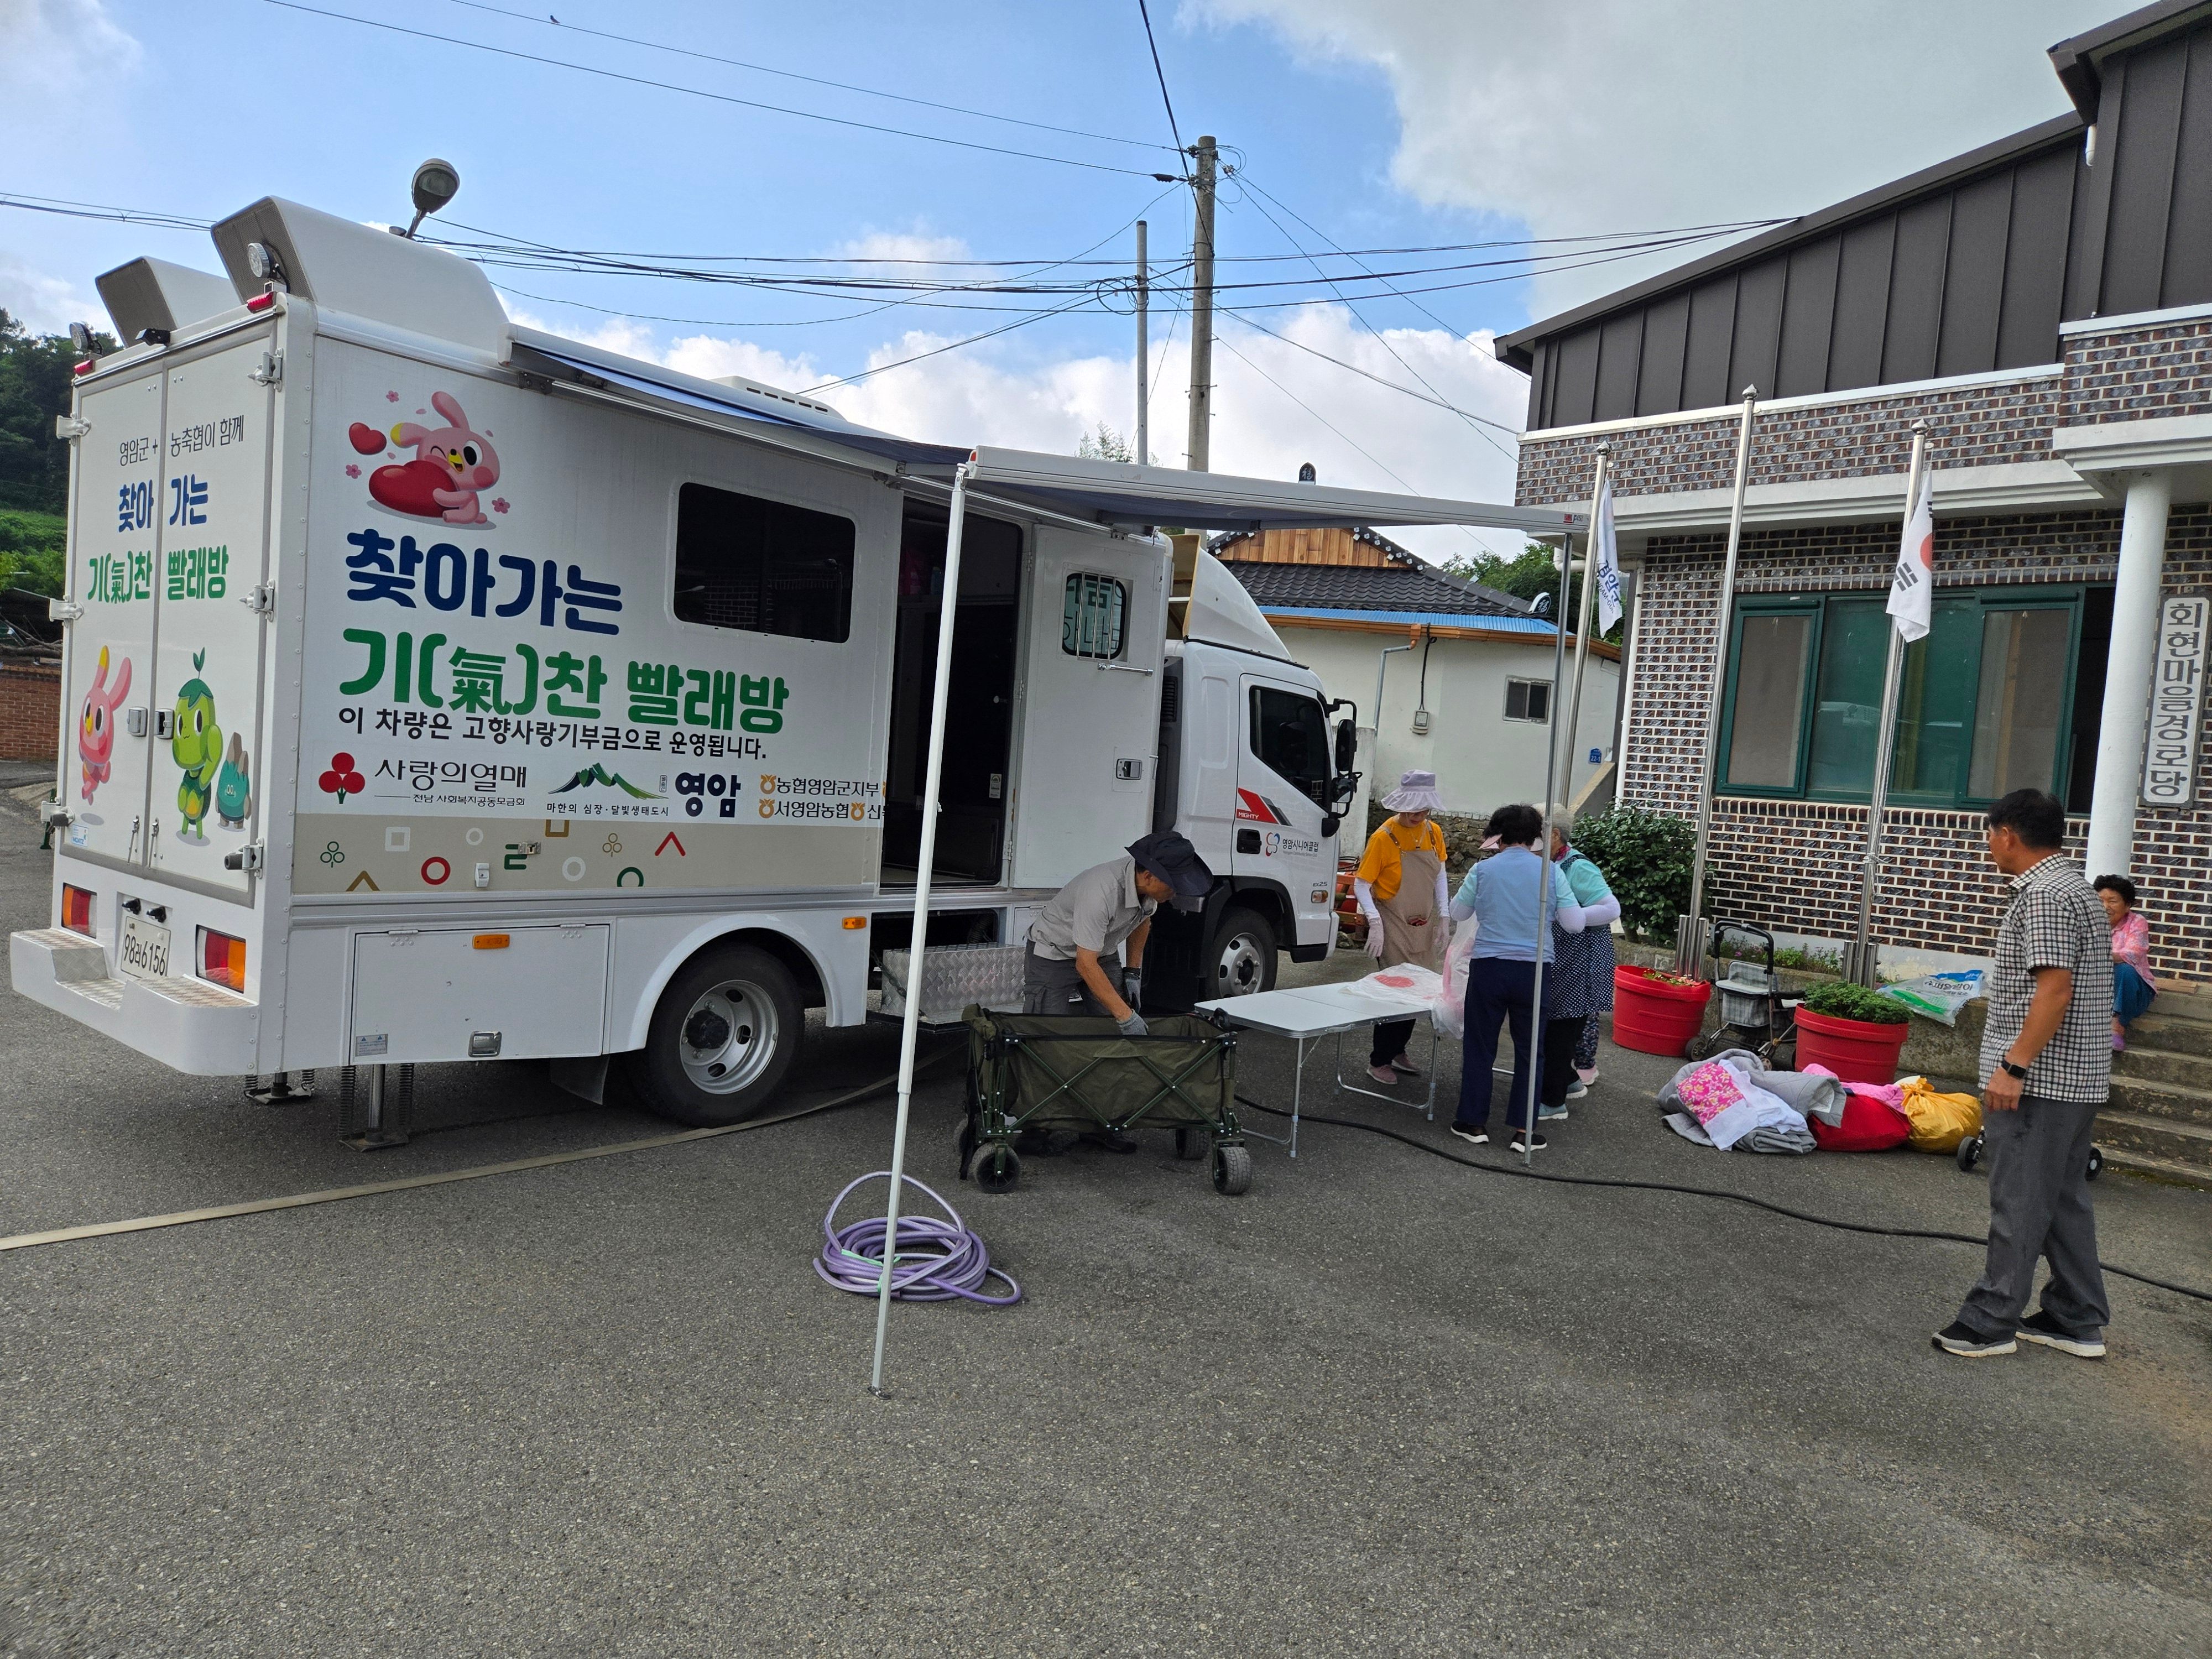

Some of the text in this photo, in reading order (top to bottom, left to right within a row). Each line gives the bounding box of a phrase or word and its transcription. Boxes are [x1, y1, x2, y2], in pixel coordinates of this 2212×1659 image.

[119, 437, 149, 466] 영암군
[170, 421, 216, 457] 농축협이
[220, 414, 244, 446] 함께
[118, 473, 208, 533] 찾아 가는
[87, 544, 229, 604] 기(氣)찬 빨래방
[345, 528, 623, 635] 찾아가는
[339, 628, 790, 734] 기(氣)찬 빨래방
[2150, 602, 2203, 797] 회현마을경로당
[338, 707, 766, 760] 이 차량은 고향사랑기부금으로 운영됩니다.
[374, 759, 527, 792] 사랑의열매
[675, 771, 742, 818] 영암
[776, 777, 880, 797] 농협영암군지부
[413, 794, 525, 808] 전남 사회복지공동모금회
[546, 802, 577, 813] 마한의
[774, 801, 849, 819] 서영암농협
[1238, 811, 1260, 820] MIGHTY
[1282, 838, 1319, 852] 영암시니어클럽
